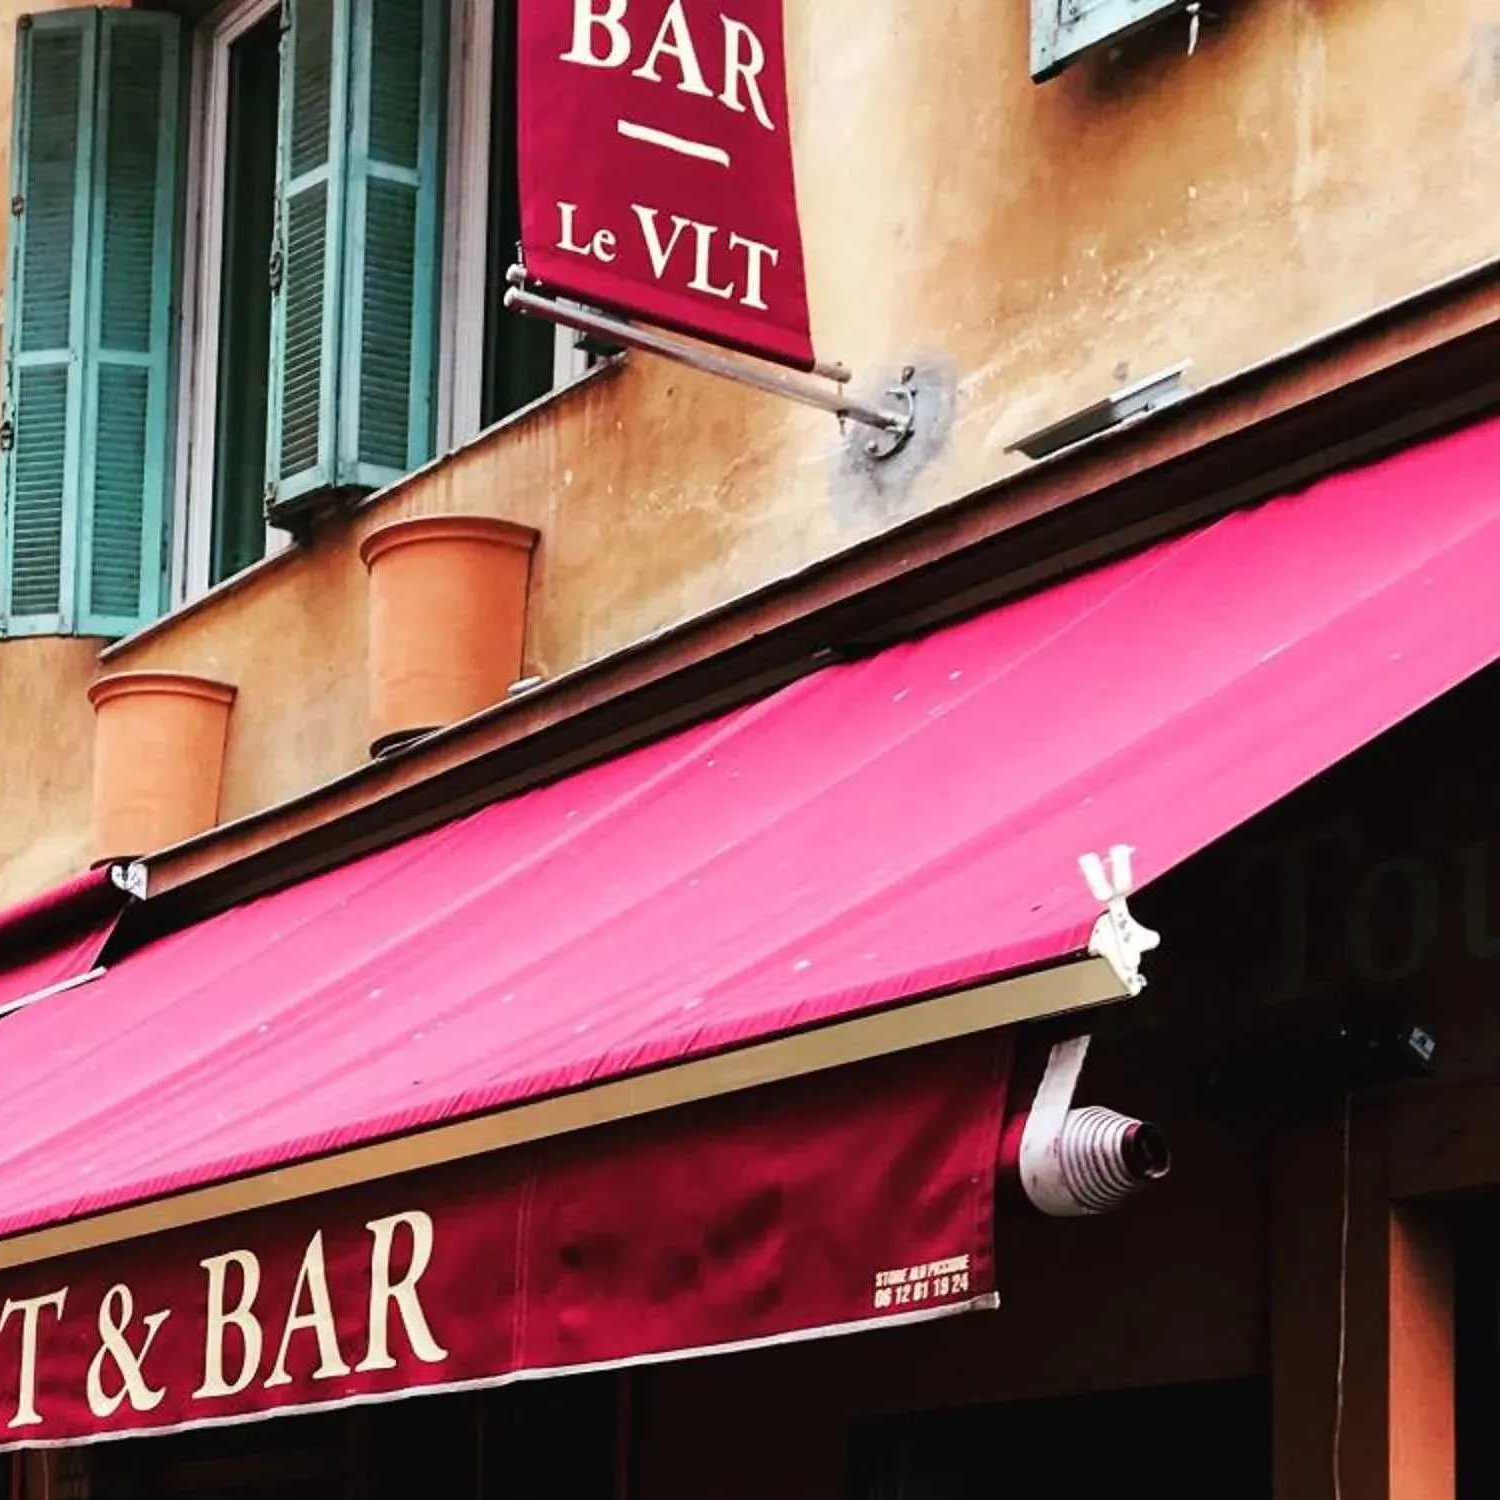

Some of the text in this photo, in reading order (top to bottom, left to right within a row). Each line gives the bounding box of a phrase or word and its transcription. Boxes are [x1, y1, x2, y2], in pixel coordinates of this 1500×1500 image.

[559, 0, 775, 131] BAR
[556, 200, 780, 311] Le VLT
[85, 1281, 172, 1418] &
[191, 1209, 449, 1403] BAR
[874, 1287, 893, 1309] 06
[895, 1284, 912, 1305] 12
[951, 1271, 970, 1294] 24
